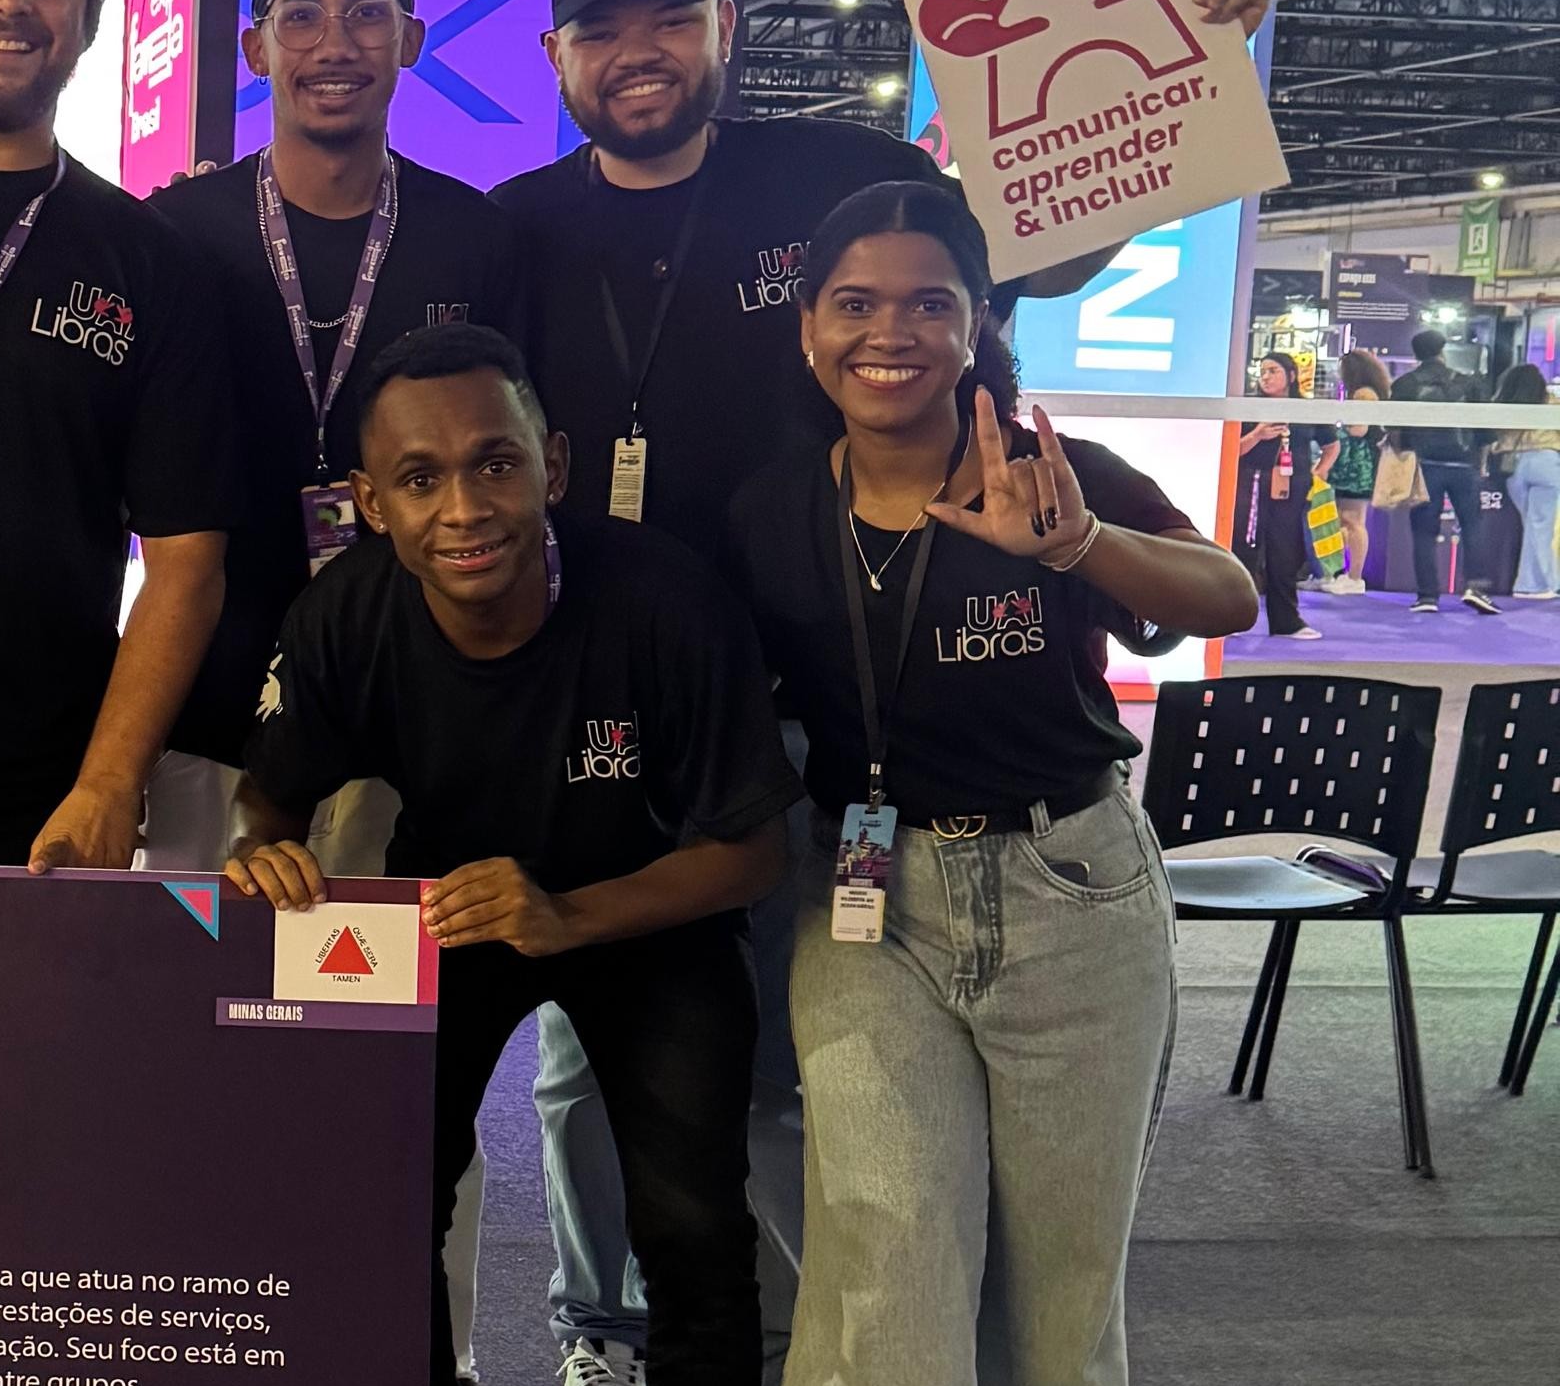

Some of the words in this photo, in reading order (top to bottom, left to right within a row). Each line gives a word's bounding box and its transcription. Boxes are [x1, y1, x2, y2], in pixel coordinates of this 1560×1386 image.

[992, 75, 1218, 172] comunicar,
[1001, 119, 1184, 207] aprender
[1013, 210, 1043, 240] &
[1042, 162, 1174, 226] incluir
[31, 298, 129, 366] Libras
[966, 587, 1043, 632] UAI
[935, 626, 1046, 662] Libras
[228, 1002, 264, 1021] MINAS
[265, 1004, 304, 1023] GERAIS
[21, 1270, 71, 1293] que
[77, 1269, 133, 1291] atua
[142, 1275, 175, 1292] no
[183, 1276, 250, 1295] ramo
[257, 1273, 290, 1297] de
[120, 1302, 154, 1326] de
[160, 1307, 271, 1335] serviços,
[66, 1336, 113, 1360] Seu
[120, 1337, 178, 1362] foco
[184, 1342, 237, 1365] está
[244, 1348, 285, 1367] em
